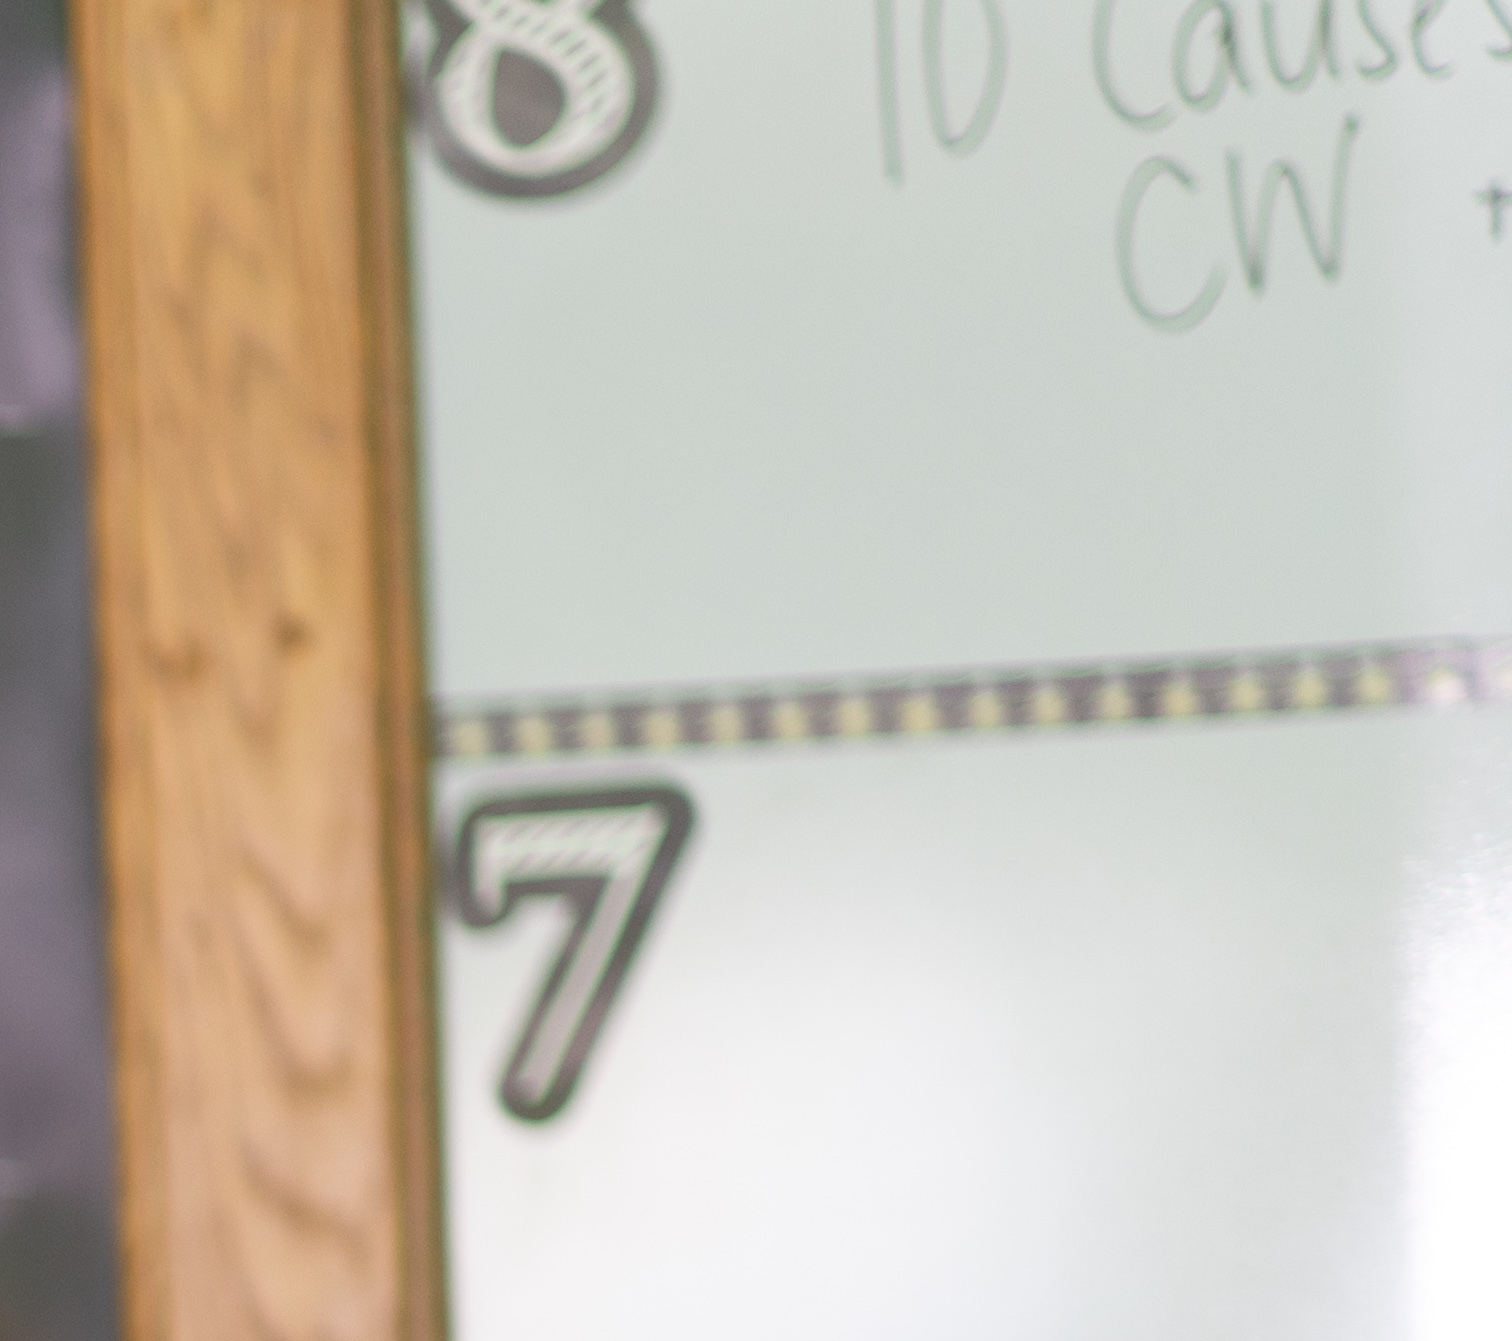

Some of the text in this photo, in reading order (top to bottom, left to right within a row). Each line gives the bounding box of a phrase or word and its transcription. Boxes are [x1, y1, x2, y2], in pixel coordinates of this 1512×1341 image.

[872, 0, 1010, 190] 10
[1116, 112, 1362, 334] CW
[452, 776, 700, 1126] 7
